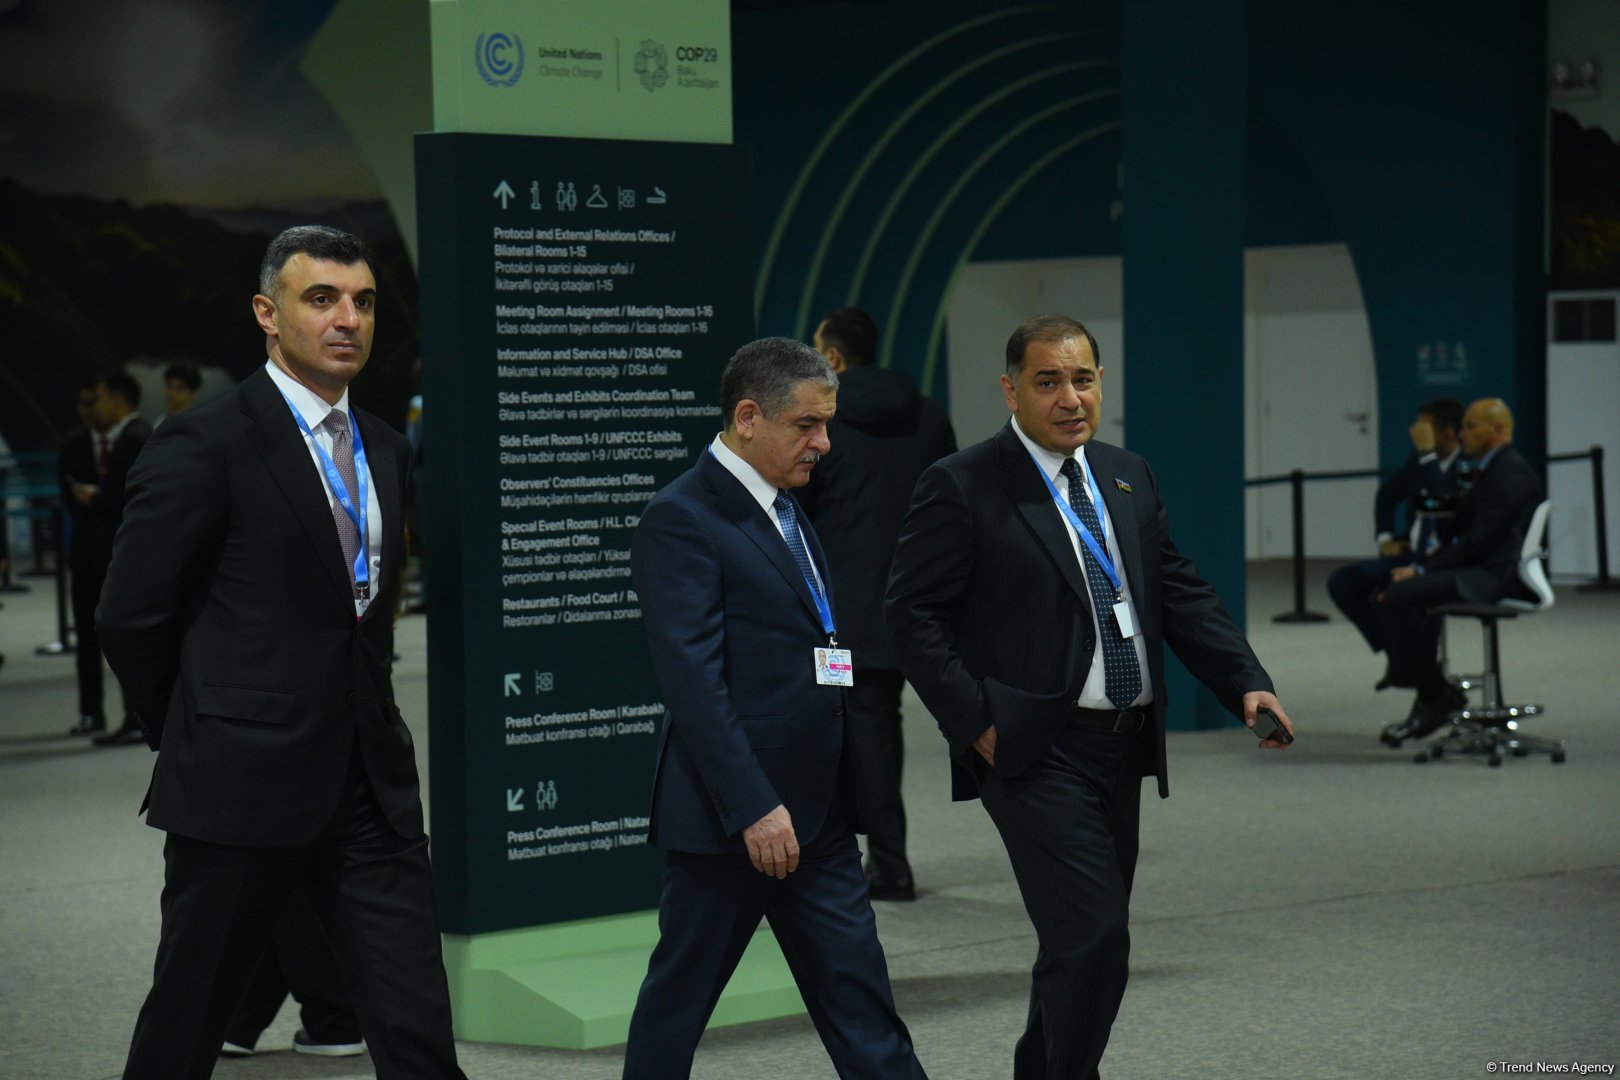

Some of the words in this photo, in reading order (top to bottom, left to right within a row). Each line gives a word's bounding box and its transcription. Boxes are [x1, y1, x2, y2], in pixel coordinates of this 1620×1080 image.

[538, 47, 566, 59] United
[569, 48, 602, 60] Nations
[676, 46, 718, 62] COP29
[540, 64, 570, 77] Climate
[572, 66, 602, 81] Change
[493, 226, 534, 240] Protocol
[535, 228, 554, 240] and
[554, 228, 593, 240] External
[594, 229, 637, 242] Relations
[638, 230, 670, 242] Offices
[494, 244, 534, 257] Bilateral
[535, 244, 568, 258] Rooms
[569, 245, 587, 258] 1-15
[494, 261, 533, 274] Protokol
[609, 262, 629, 275] ofisi
[533, 278, 560, 294] görüş
[596, 279, 614, 292] 1-15
[496, 304, 535, 320] Meeting
[536, 304, 564, 318] Room
[565, 304, 620, 320] Assignment
[626, 304, 664, 320] Meeting
[664, 305, 696, 318] Rooms
[696, 305, 714, 318] 1-16
[691, 321, 708, 334] 1-16
[496, 348, 552, 361] Information
[552, 348, 571, 360] and
[572, 348, 608, 360] Service
[608, 347, 628, 360] Hub
[634, 347, 654, 360] DSA
[655, 346, 683, 360] Office
[628, 364, 648, 376] DSA
[648, 364, 668, 376] ofisi
[498, 392, 520, 404] Side
[521, 391, 554, 404] Events
[554, 391, 573, 404] and
[574, 390, 611, 403] Exhibits
[612, 389, 670, 402] Coordination
[670, 388, 696, 400] Team
[621, 405, 675, 420] koordinasiya
[499, 434, 522, 448] Side
[522, 434, 550, 446] Event
[550, 434, 584, 446] Rooms
[584, 432, 599, 445] 1-9
[606, 431, 646, 444] UNFCCC
[646, 430, 682, 443] Exhibits
[591, 448, 606, 462] 1-9
[612, 447, 653, 460] UNFCCC
[500, 477, 552, 491] Observers'
[552, 474, 622, 489] Constituencies
[622, 473, 656, 486] Offices
[500, 520, 537, 536] Special
[538, 519, 565, 532] Event
[566, 518, 600, 531] Rooms
[606, 516, 624, 528] H.L.
[501, 538, 510, 551] &
[510, 535, 571, 552] Engagement
[572, 534, 600, 547] Office
[502, 554, 533, 568] Xüsusi
[502, 570, 554, 587] çempionlar
[502, 596, 560, 611] Restaurants
[567, 594, 592, 606] Food
[592, 591, 618, 604] Court
[503, 614, 556, 628] Restoranlar
[563, 608, 612, 624] Qidalanma
[505, 716, 533, 729] Press
[533, 711, 588, 727] Conference
[589, 708, 616, 720] Room
[622, 702, 665, 718] Karabakh
[616, 720, 656, 736] Qarabağ
[507, 830, 535, 844] Press
[536, 824, 590, 840] Conference
[591, 820, 618, 833] Room
